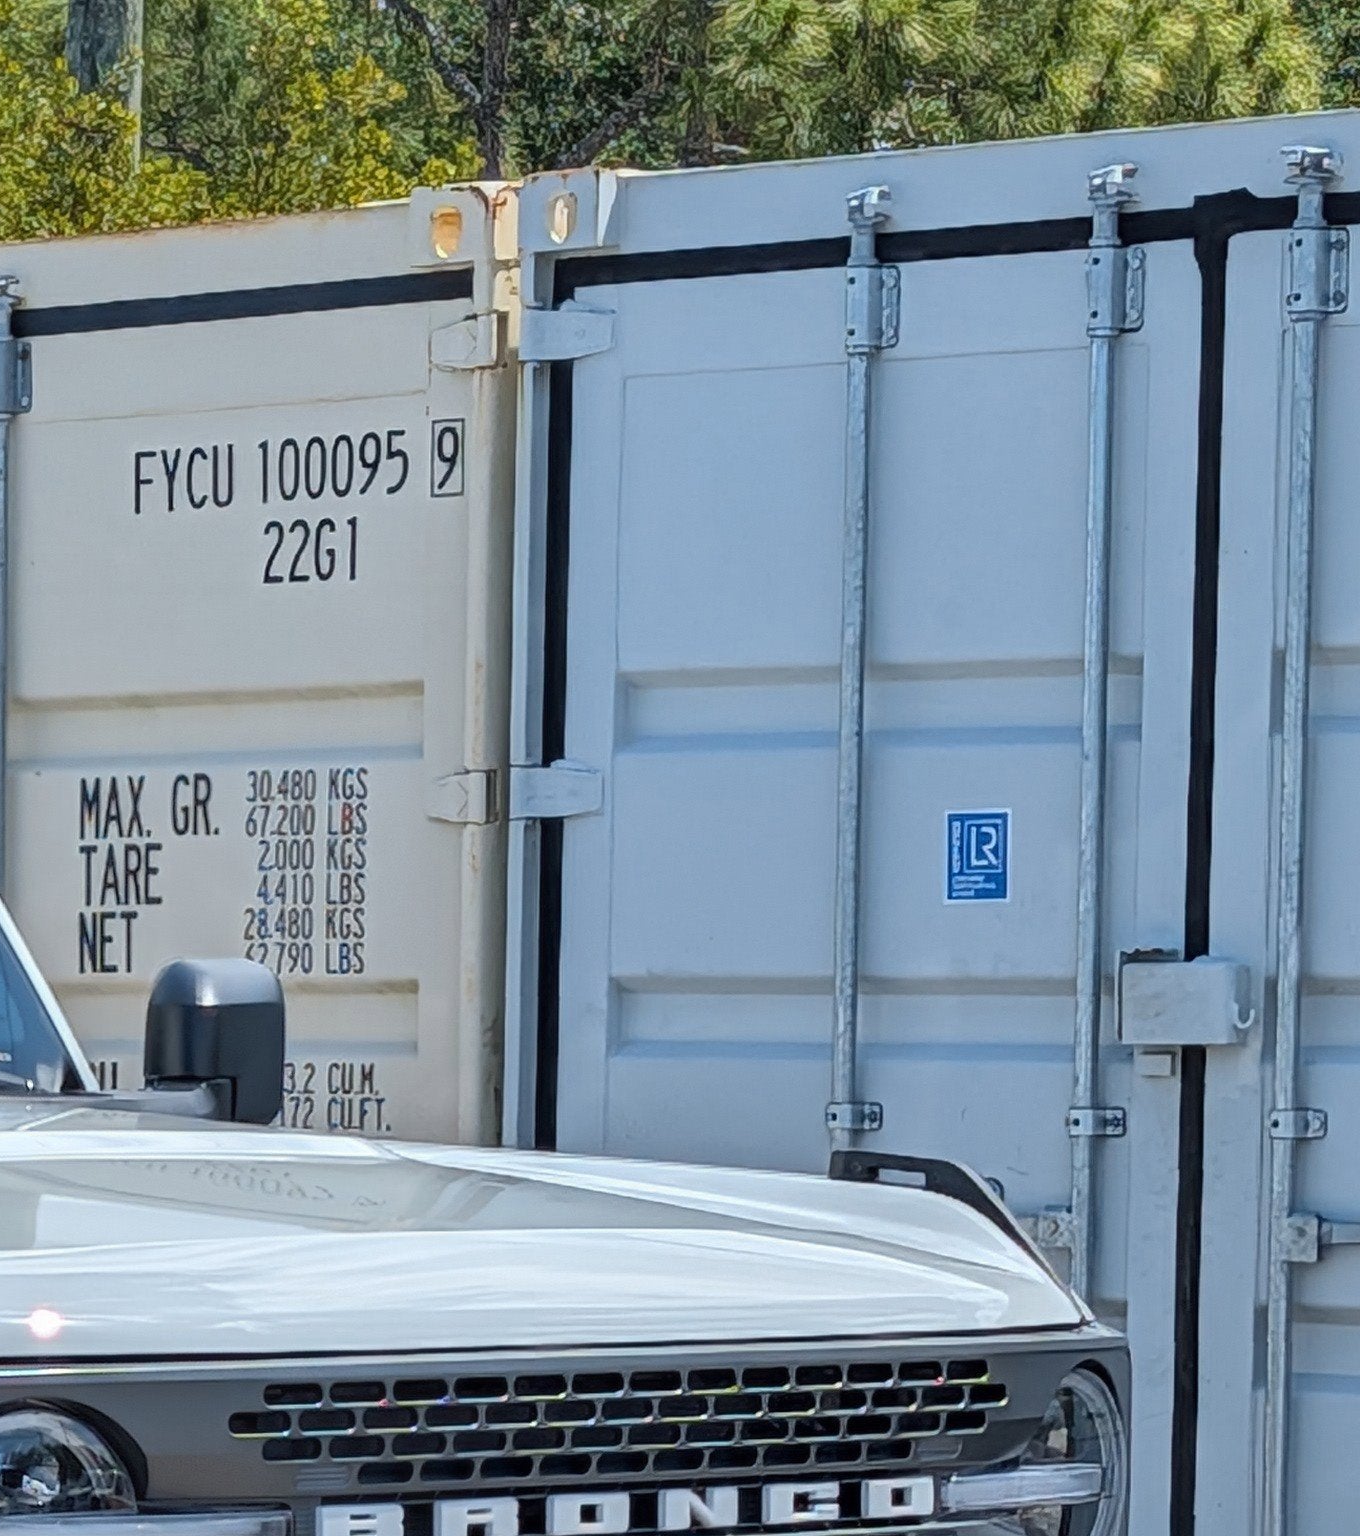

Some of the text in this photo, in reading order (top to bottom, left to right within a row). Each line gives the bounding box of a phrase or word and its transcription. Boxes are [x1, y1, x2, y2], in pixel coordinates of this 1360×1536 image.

[134, 426, 459, 515] FYCU 100095 9
[263, 516, 357, 584] 22G1
[80, 767, 368, 840] MAX. GR. 30.480 KGS
[245, 803, 368, 837] 67.200 LBS
[79, 837, 367, 906] TARE 2.000 KGS
[256, 872, 366, 905] 4.410 LBS
[79, 907, 365, 974] NET 28.480 KGS
[325, 942, 365, 974] LBS
[283, 1062, 316, 1095] 3.2
